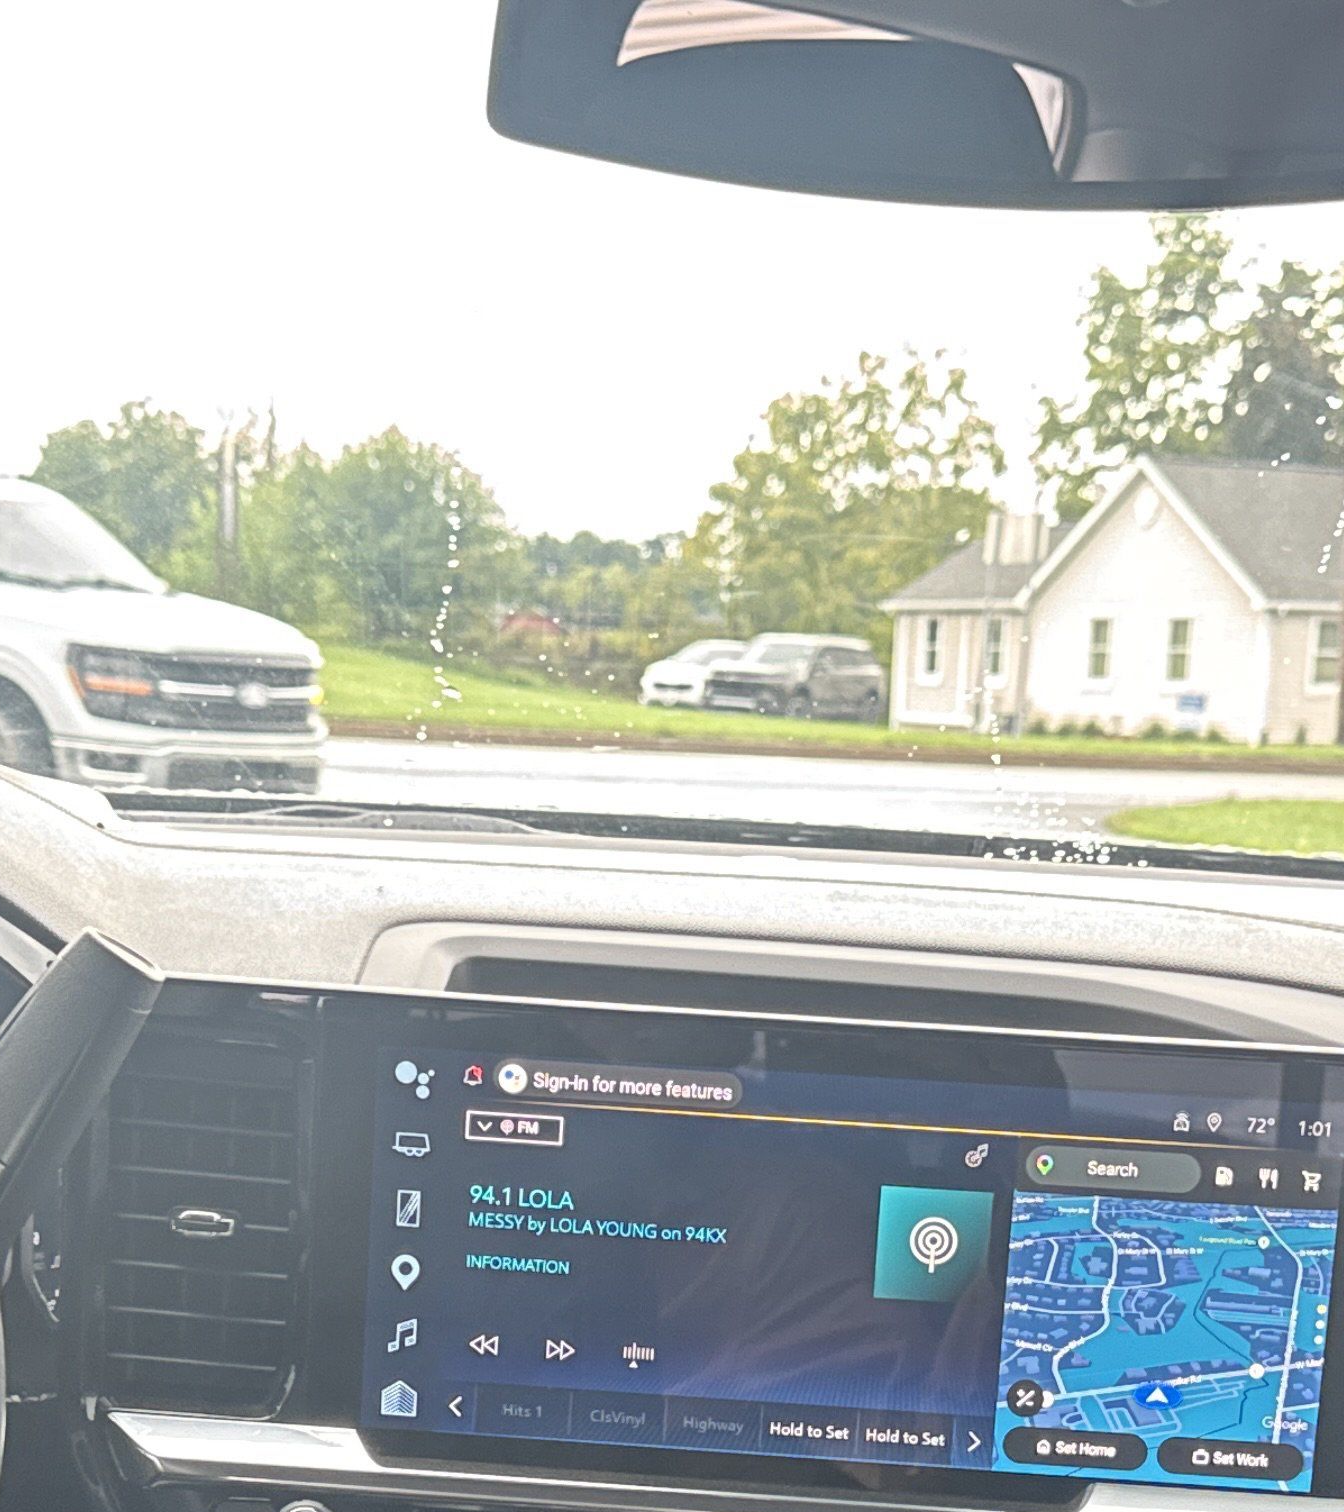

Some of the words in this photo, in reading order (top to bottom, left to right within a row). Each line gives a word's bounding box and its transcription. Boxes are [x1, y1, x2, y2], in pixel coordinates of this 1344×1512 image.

[532, 1072, 592, 1097] Sign-in
[592, 1075, 617, 1095] for
[619, 1080, 662, 1097] more
[664, 1080, 734, 1102] features
[517, 1120, 540, 1137] FM
[1298, 1120, 1333, 1138] 1:01
[1086, 1160, 1139, 1179] Search
[469, 1184, 513, 1208] 94.1
[517, 1188, 575, 1211] LOLA
[468, 1212, 525, 1232] MESSY
[526, 1214, 547, 1236] by
[549, 1217, 594, 1236] LOLA
[595, 1220, 658, 1241] YOUNG
[660, 1227, 682, 1242] on
[685, 1225, 728, 1245] 94KX
[465, 1254, 570, 1275] INFORMATION
[502, 1403, 530, 1419] Hits
[535, 1405, 543, 1419] 1
[683, 1415, 744, 1436] Highway
[769, 1421, 805, 1439] Hold
[807, 1424, 823, 1440] to
[825, 1425, 850, 1442] Set
[1261, 1416, 1308, 1432] Google
[865, 1427, 900, 1445] Hold
[903, 1430, 919, 1446] to
[921, 1430, 946, 1448] Set
[1055, 1441, 1077, 1455] Set
[1079, 1443, 1117, 1459] Home
[1212, 1451, 1235, 1466] Set
[1236, 1453, 1269, 1469] Work
